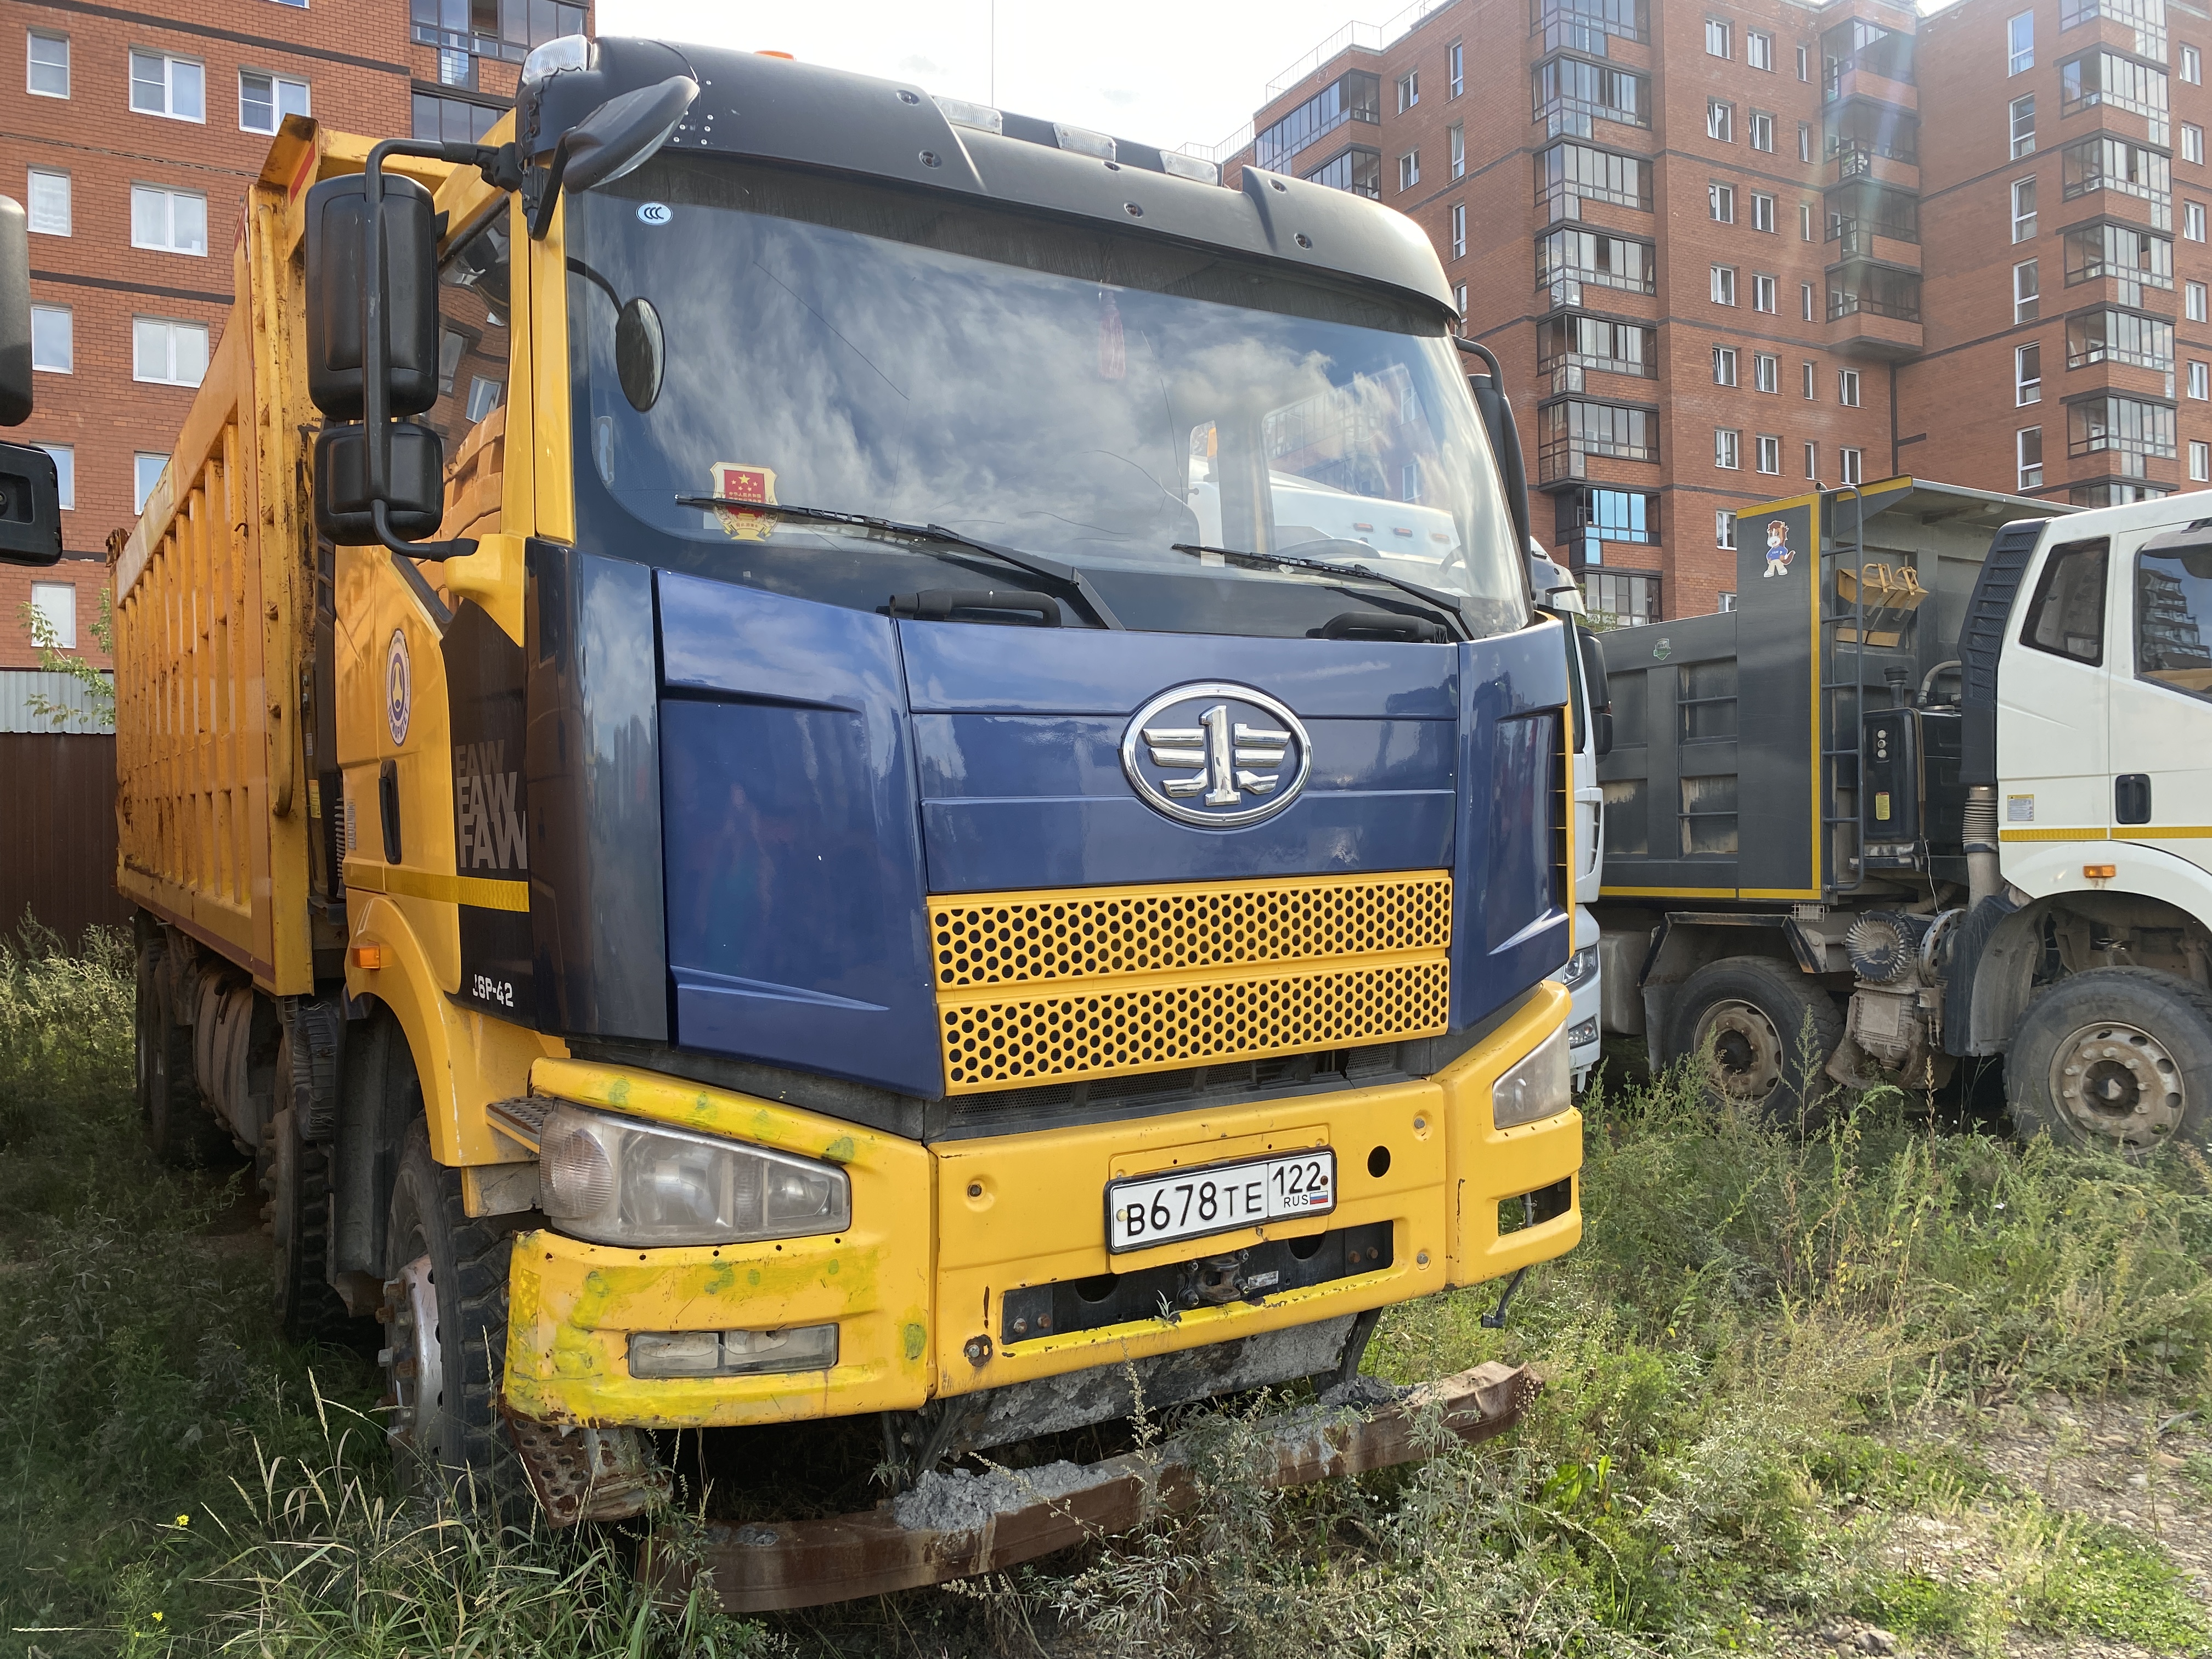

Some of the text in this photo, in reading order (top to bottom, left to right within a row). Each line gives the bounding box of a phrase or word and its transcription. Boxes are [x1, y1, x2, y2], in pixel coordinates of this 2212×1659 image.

[455, 740, 504, 778] FAW
[456, 771, 517, 815] FAW
[458, 811, 528, 869] FAW
[1272, 1161, 1321, 1196] 122
[1284, 1194, 1309, 1208] RUS
